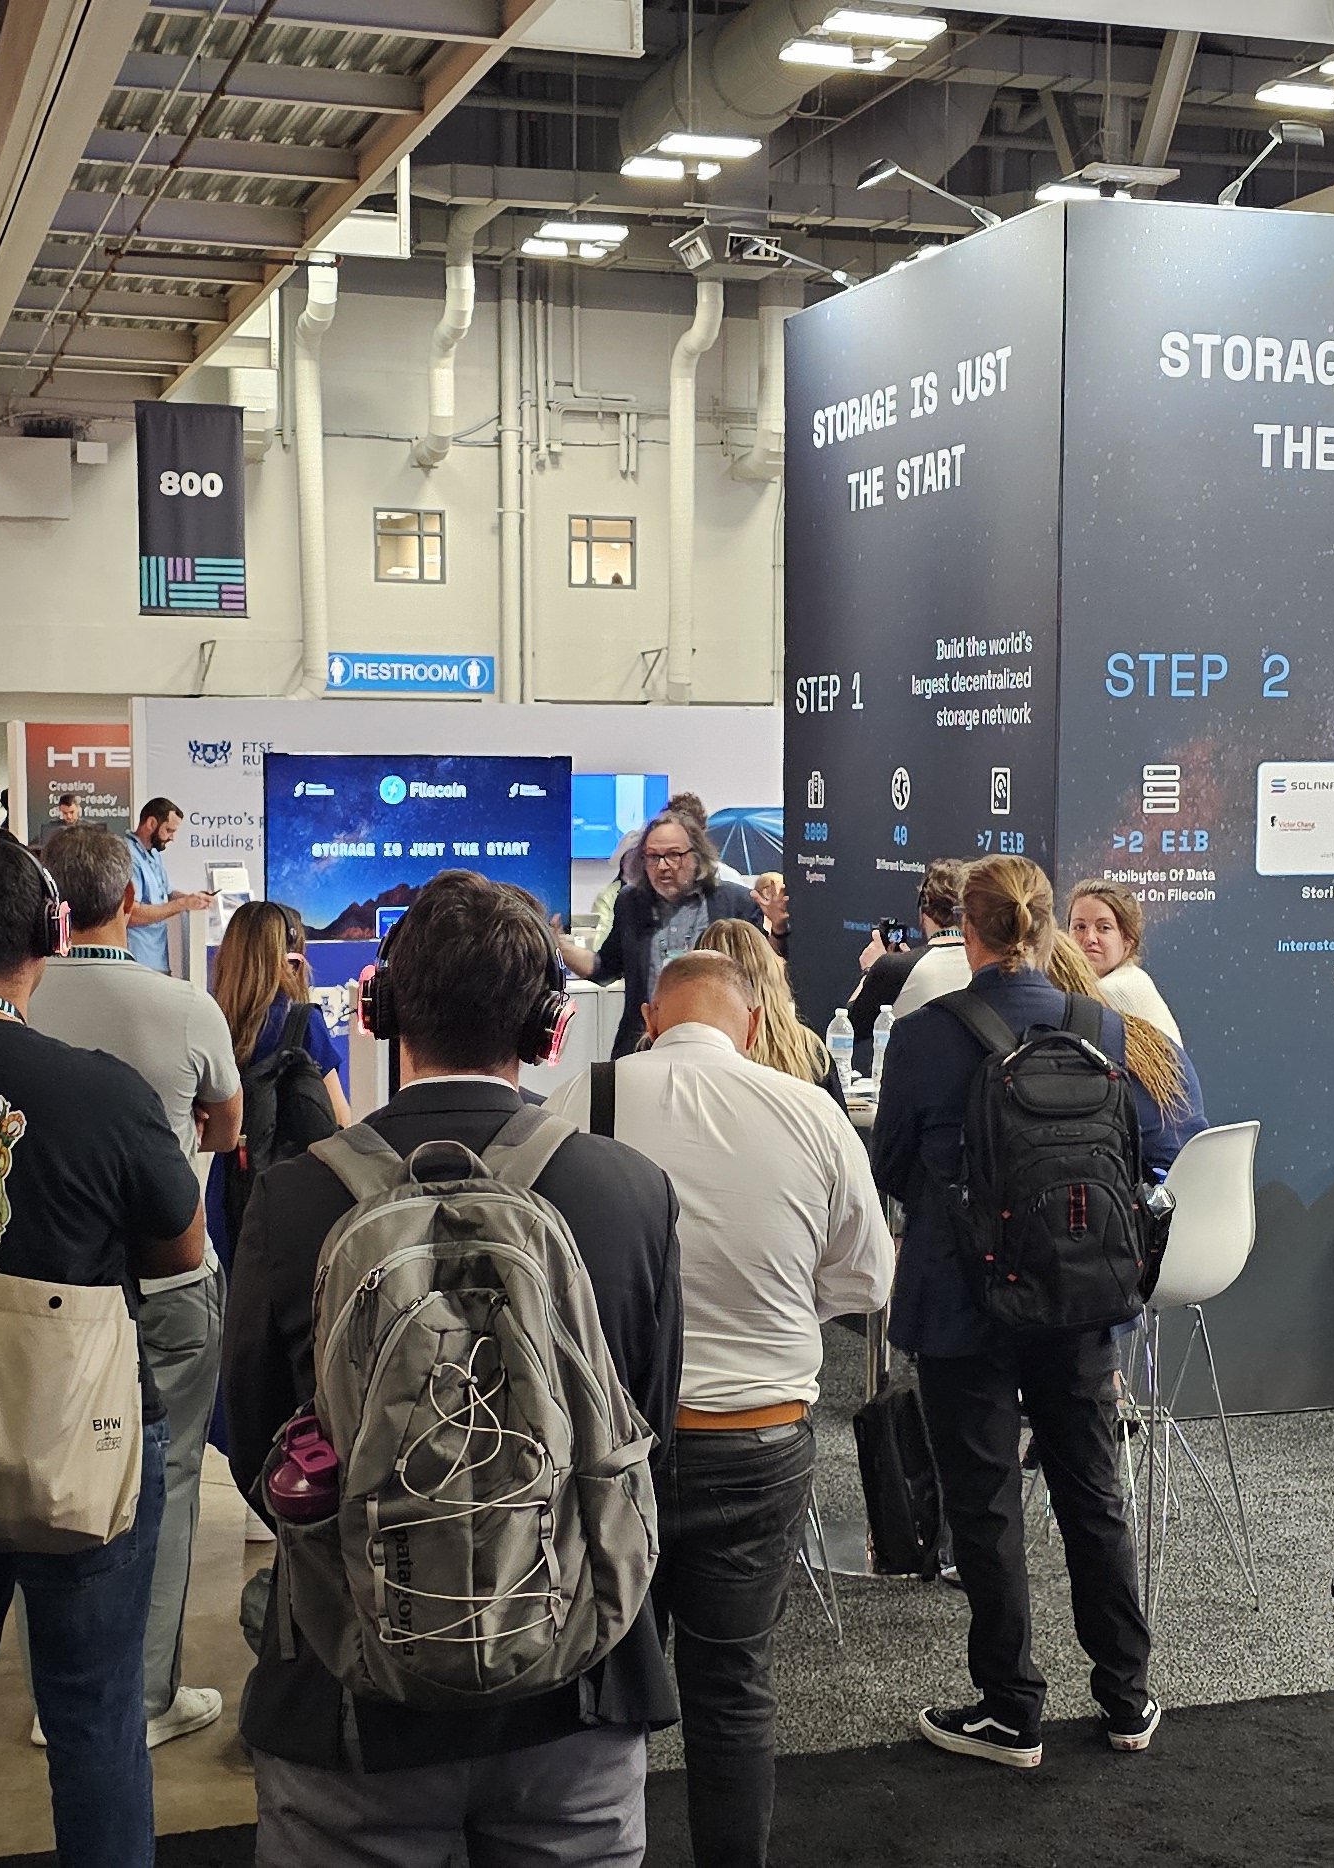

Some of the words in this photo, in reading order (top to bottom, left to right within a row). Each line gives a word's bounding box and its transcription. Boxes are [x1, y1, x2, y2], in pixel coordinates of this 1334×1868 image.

[813, 384, 897, 448] STORAGE
[911, 371, 938, 419] IS
[952, 346, 1011, 406] JUST
[159, 471, 223, 498] 800
[847, 466, 883, 511] THE
[896, 444, 965, 500] START
[936, 637, 964, 660] Build
[966, 636, 987, 657] the
[989, 630, 1033, 656] world's
[353, 663, 458, 682] RESTROOM
[1105, 652, 1229, 699] STEP
[1262, 654, 1290, 698] 2
[912, 674, 949, 699] largest
[951, 666, 1032, 693] decentralized
[796, 674, 840, 714] STEP
[852, 672, 863, 709] 1
[936, 707, 979, 730] storage
[982, 702, 1032, 725] network
[49, 780, 94, 793] Creating
[409, 782, 467, 798] Filecoin
[49, 794, 117, 806] fue-ready
[84, 806, 129, 817] financial
[190, 812, 254, 828] Crypto's
[191, 834, 253, 851] Building
[894, 826, 907, 845] 40
[977, 830, 992, 851] >7
[1000, 831, 1024, 854] EiB
[1113, 830, 1143, 853] >2
[1161, 830, 1209, 852] EiB
[311, 843, 375, 857] STORAGE
[384, 843, 402, 857] IS
[410, 843, 445, 856] JUST
[453, 842, 479, 856] THE
[486, 842, 530, 856] START
[1104, 869, 1167, 884] Exbibytes
[1169, 869, 1184, 881] Of
[1187, 869, 1216, 881] Data
[1148, 889, 1165, 901] On
[1168, 888, 1216, 900] Filecoin
[93, 1417, 121, 1431] BMW
